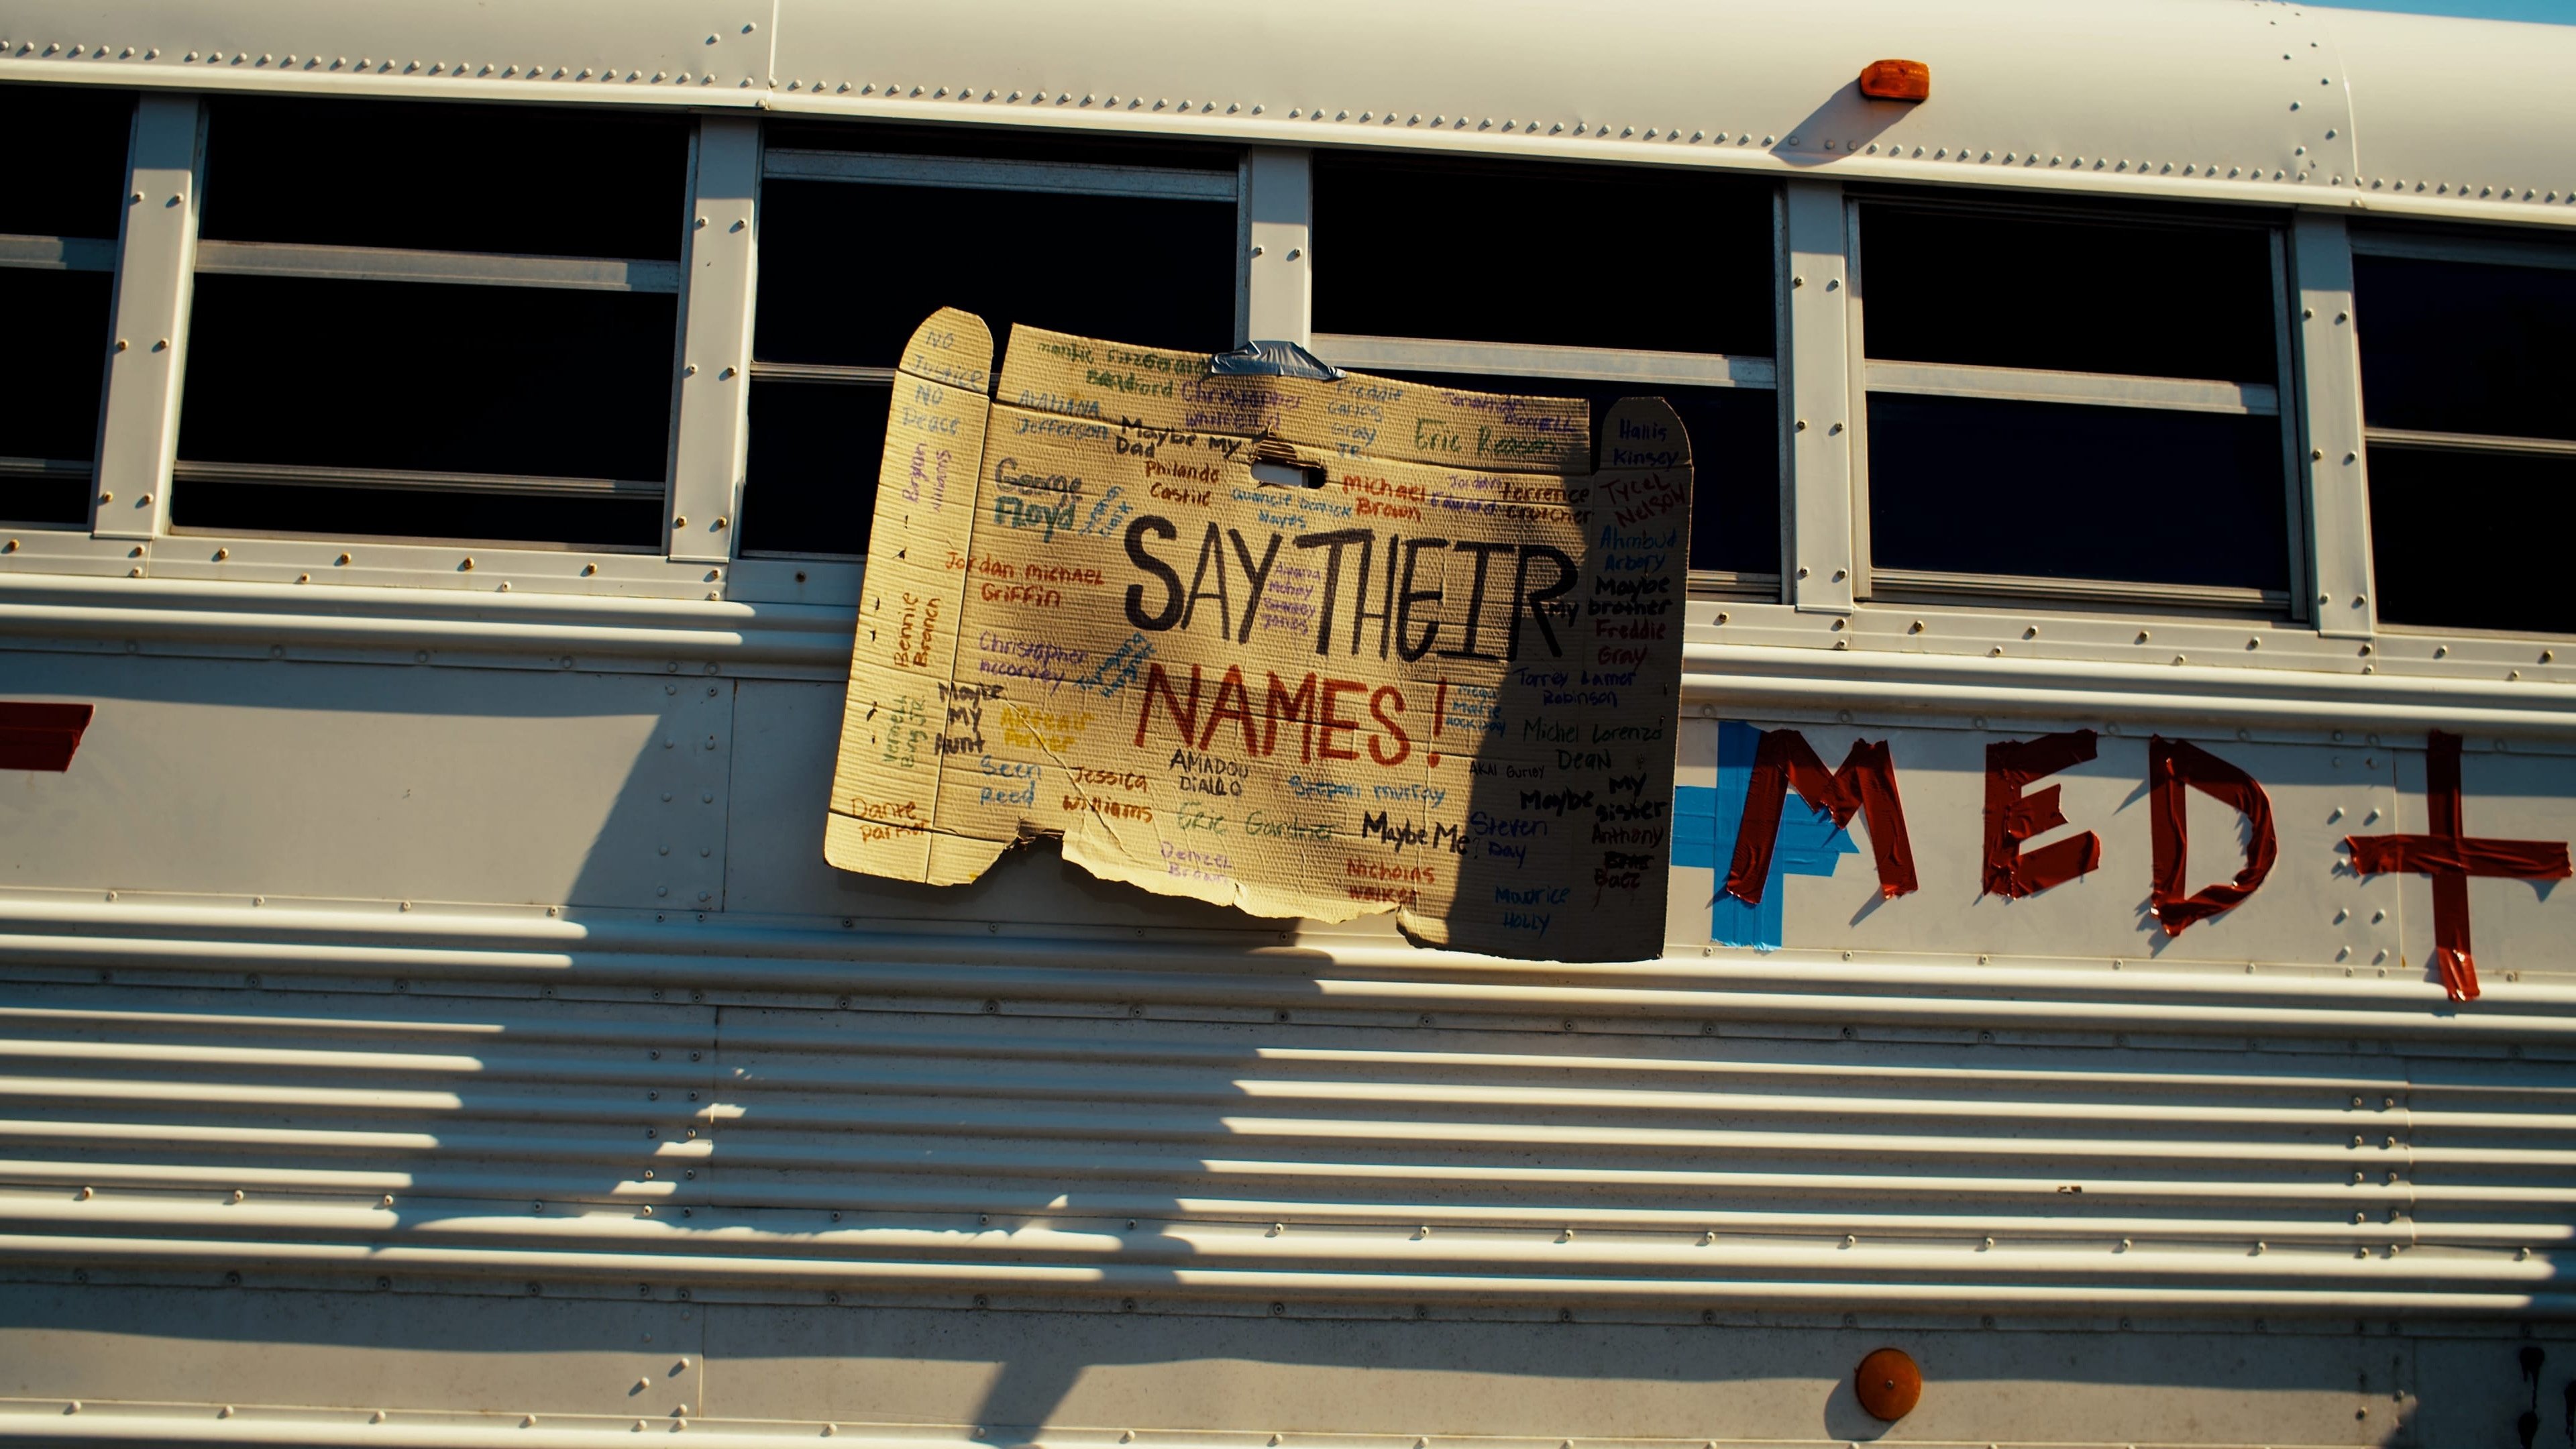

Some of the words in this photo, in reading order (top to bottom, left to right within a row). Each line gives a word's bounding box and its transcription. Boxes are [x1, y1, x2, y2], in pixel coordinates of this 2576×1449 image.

[926, 331, 954, 350] NO
[915, 384, 944, 407] NO
[902, 407, 960, 435] Peace
[1122, 415, 1197, 447] Maybe
[1619, 418, 1668, 441] Hallis
[1115, 435, 1156, 458] Dad
[1414, 417, 1462, 453] Eric
[1144, 460, 1220, 484] Philando
[1613, 448, 1679, 472] Kinsey
[996, 458, 1082, 508] George
[994, 496, 1076, 542] Floyd
[1356, 496, 1421, 523] Brown
[945, 551, 1015, 578] Jordan
[1124, 515, 1284, 645] SAY
[1293, 528, 1579, 662] THEIR
[1595, 574, 1670, 604] Maybe
[1587, 596, 1674, 616] brother
[894, 592, 918, 668] Bennie
[913, 598, 941, 667] Branch
[1595, 618, 1666, 640] Freddie
[1597, 645, 1648, 671] Gray
[1513, 667, 1568, 689] Torrey
[1543, 690, 1618, 708] Robinson
[1134, 662, 1450, 767] NAMES!
[934, 731, 985, 755] Aunt
[1593, 724, 1663, 745] Lorenzo
[1072, 767, 1147, 793] Jessica
[851, 798, 916, 820] Dante
[1520, 786, 1594, 816] Maybe
[1362, 810, 1428, 853] Maybe
[1470, 812, 1548, 837] Steven
[1591, 822, 1664, 848] Anthony
[1488, 841, 1526, 869] Day
[1495, 885, 1570, 905] Maurice
